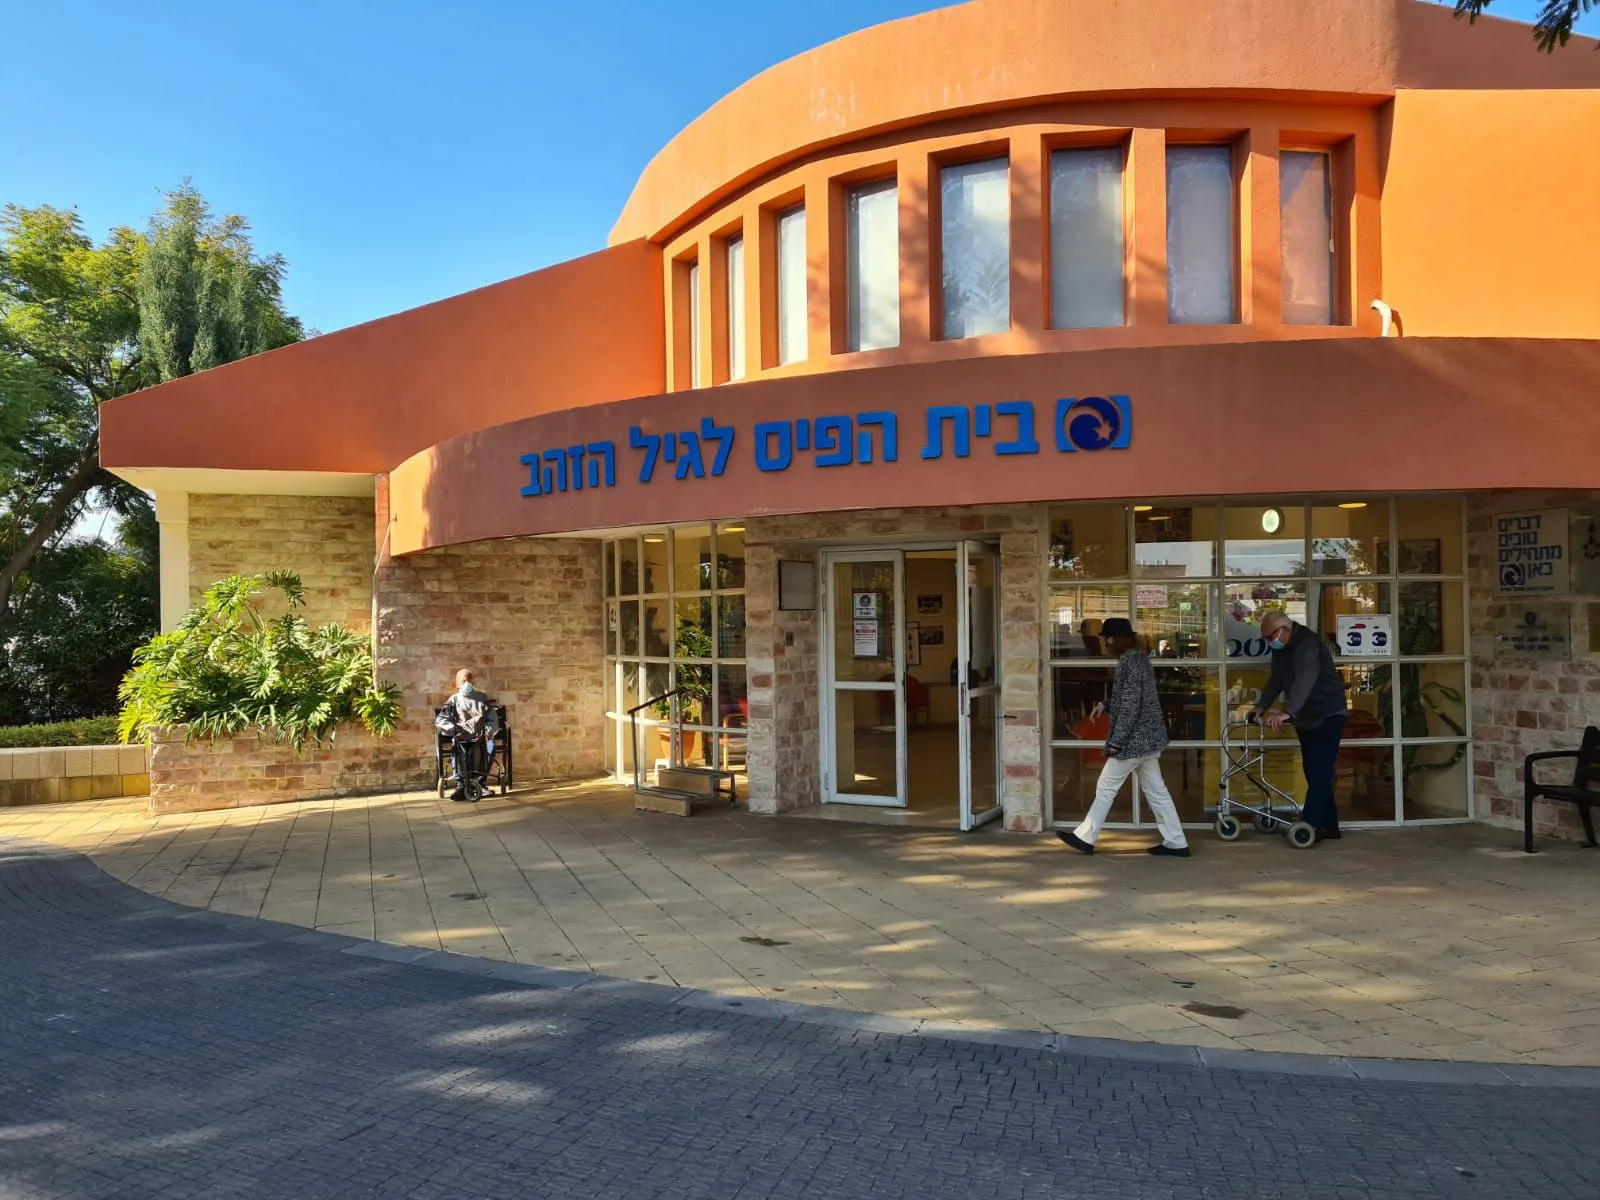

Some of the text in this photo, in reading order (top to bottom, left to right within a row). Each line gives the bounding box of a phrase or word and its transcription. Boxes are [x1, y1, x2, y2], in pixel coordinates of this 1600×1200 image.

[519, 401, 1039, 497] בית הפיס לגיל הזהב
[1498, 515, 1542, 532] דברים
[1498, 531, 1538, 547] טובים
[1499, 545, 1563, 562] מתחילים
[1528, 562, 1553, 579] כאן
